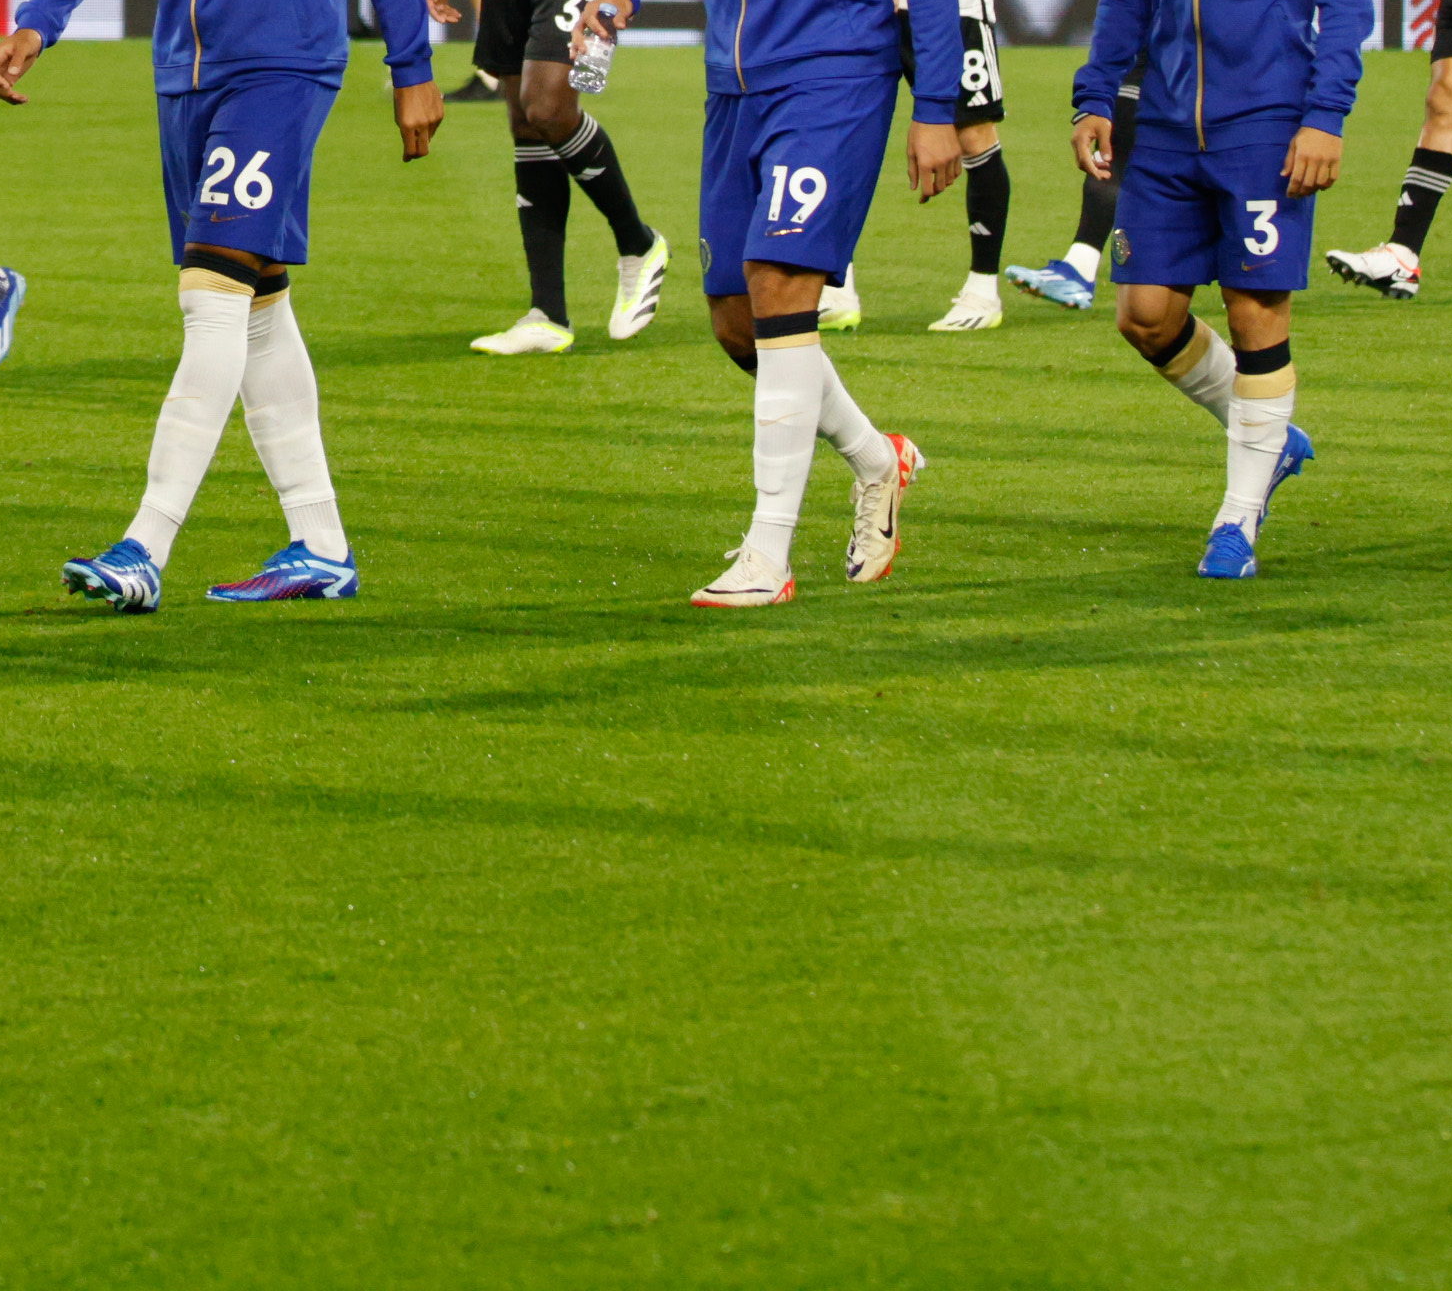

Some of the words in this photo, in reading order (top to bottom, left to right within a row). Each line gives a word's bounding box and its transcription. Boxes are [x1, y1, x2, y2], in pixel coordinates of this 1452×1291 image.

[199, 145, 274, 210] 26
[768, 165, 828, 225] 19
[1243, 199, 1279, 256] 3
